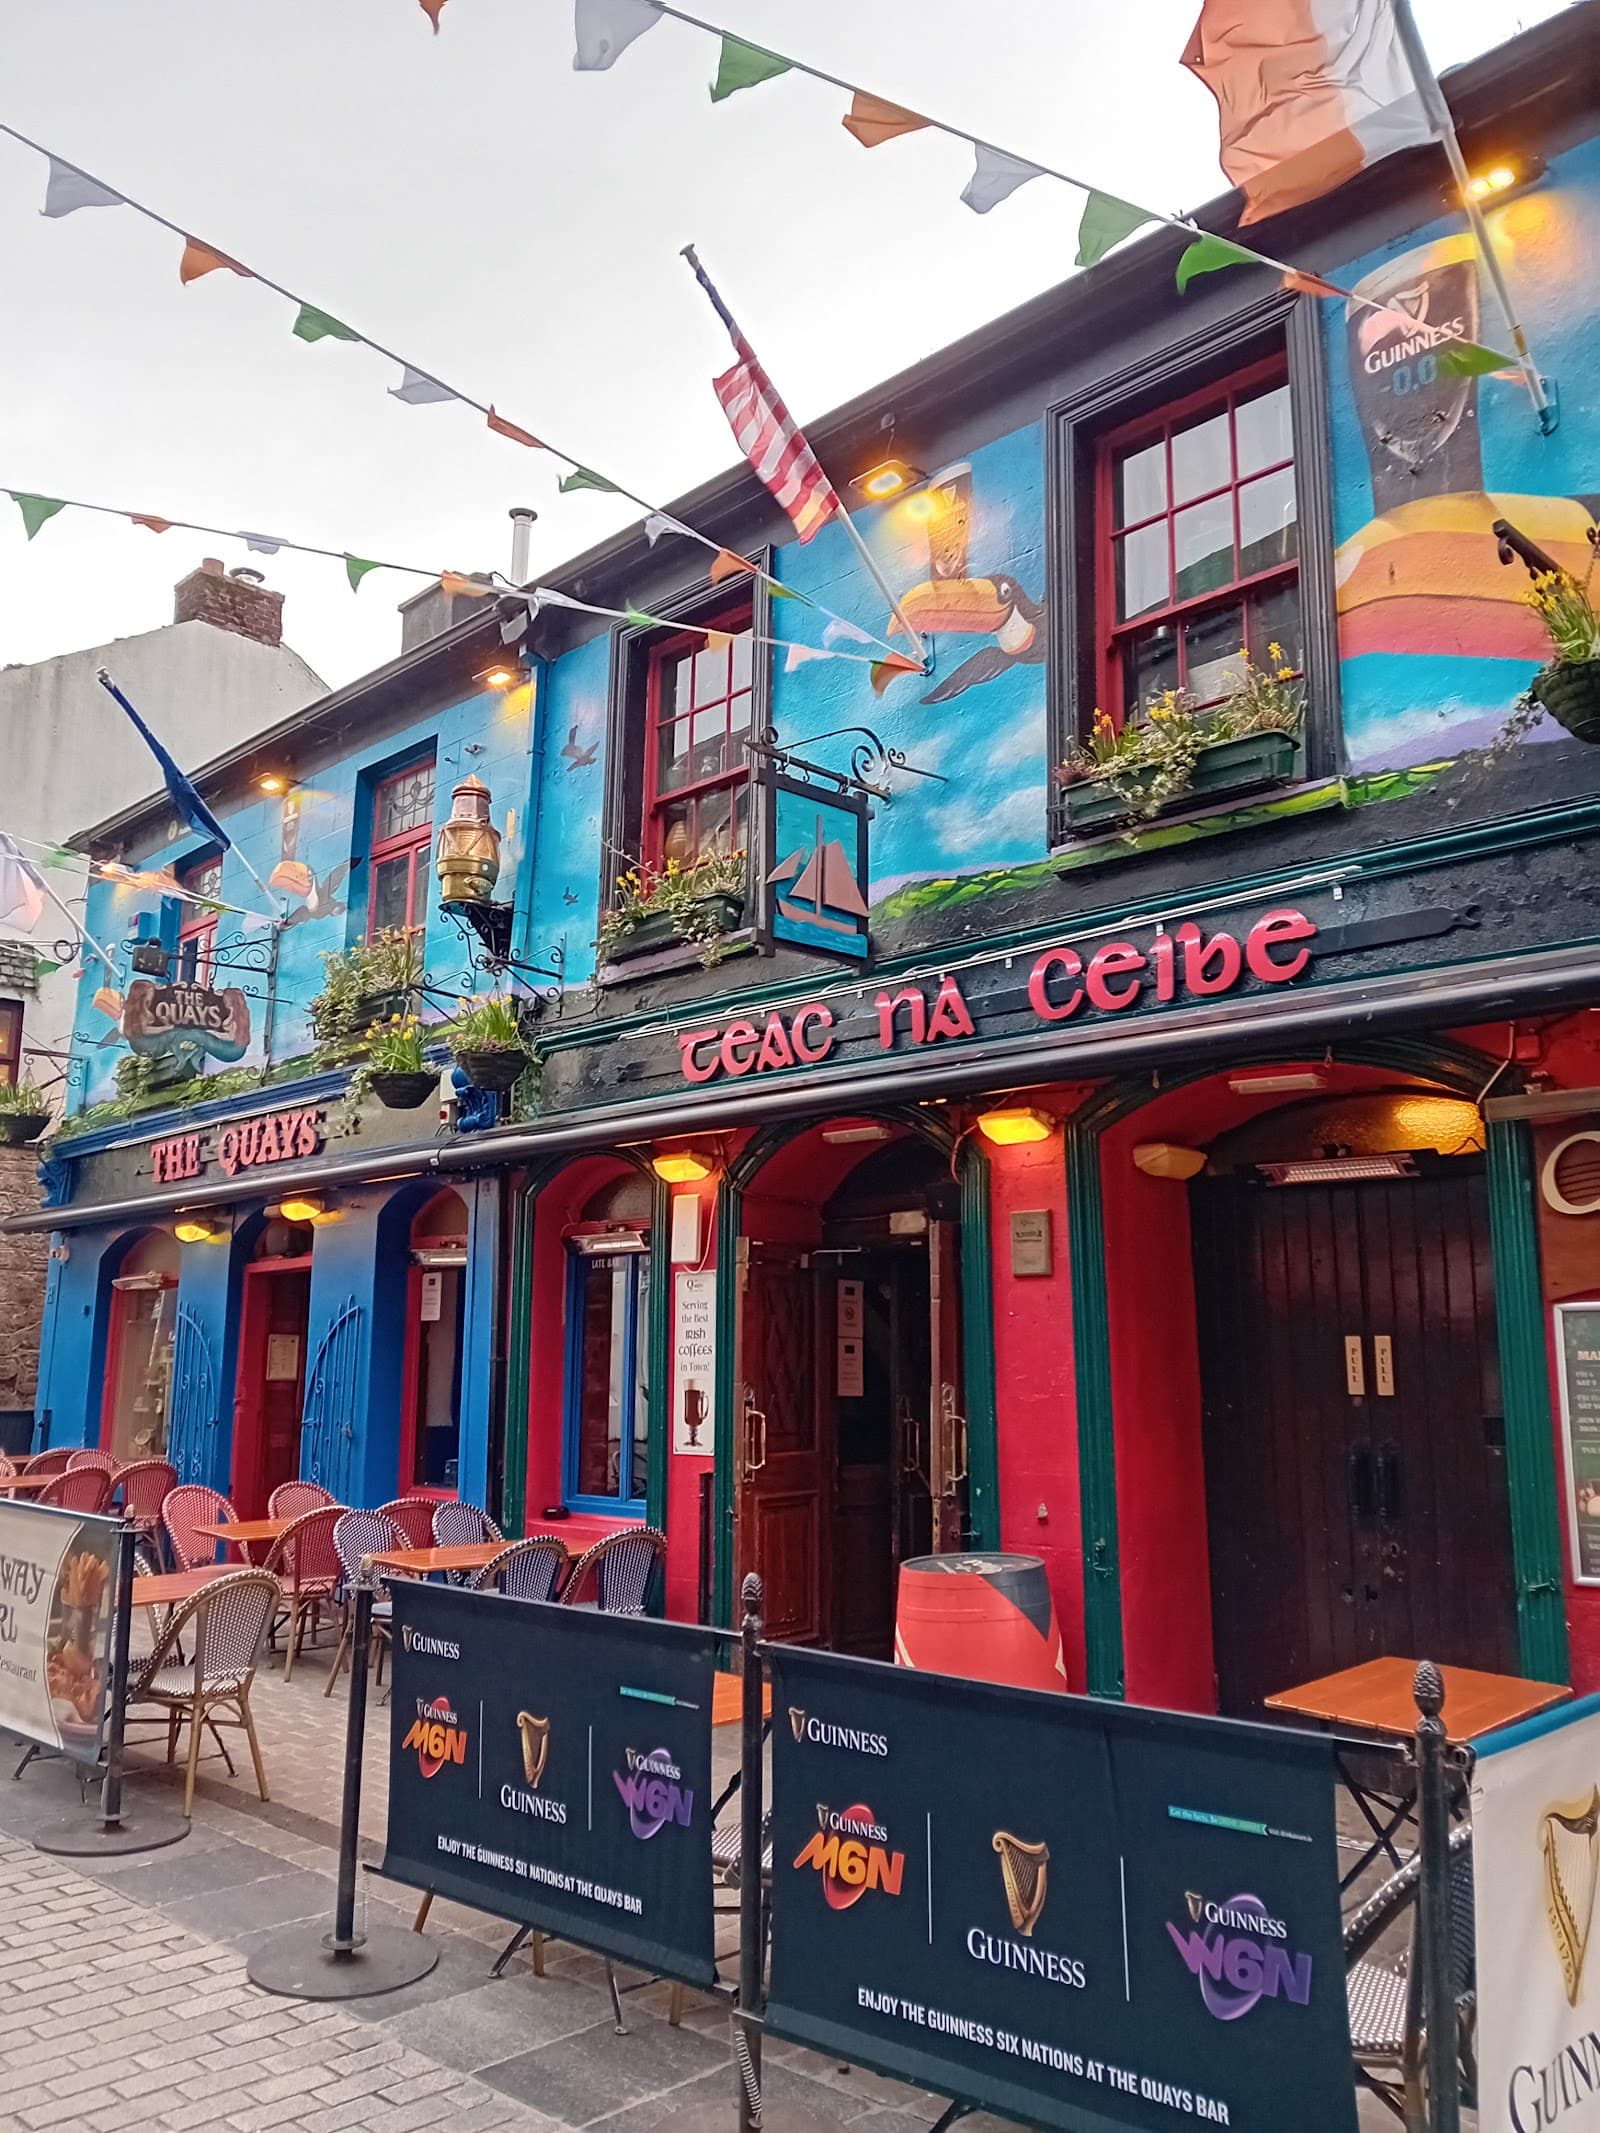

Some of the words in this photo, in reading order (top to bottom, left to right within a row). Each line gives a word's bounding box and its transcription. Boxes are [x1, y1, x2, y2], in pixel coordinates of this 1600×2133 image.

[1364, 317, 1464, 374] GUINNESS
[1393, 353, 1438, 395] 0.0
[155, 1002, 221, 1027] QUAYS
[174, 990, 203, 1006] THE
[151, 1134, 199, 1183] THE
[218, 1109, 317, 1176] QUAYS
[682, 1301, 708, 1310] Serving
[682, 1313, 691, 1323] the
[694, 1313, 708, 1323] Best
[680, 1363, 687, 1372] in
[412, 1632, 460, 1660] GUINNESS
[0, 1655, 37, 1682] estaurant
[423, 1705, 458, 1725] GUINNESS
[402, 1719, 467, 1765] M6N
[807, 1718, 888, 1756] GUINNESS
[635, 1754, 681, 1780] GUINNESS
[500, 1784, 567, 1824] GUINNESS
[613, 1769, 694, 1827] W6N
[829, 1812, 888, 1841] GUINNESS
[437, 1835, 462, 1855] ENJOY
[461, 1842, 477, 1860] THE
[477, 1847, 515, 1873] GUINNESS
[515, 1859, 528, 1878] SIX
[529, 1865, 564, 1889] NATIONS
[564, 1876, 576, 1893] AT
[576, 1879, 593, 1899] THE
[594, 1886, 623, 1908] QUAYS
[624, 1895, 642, 1915] BAR
[793, 1832, 905, 1895] M6N
[1205, 1902, 1287, 1939] GUINNESS
[967, 1928, 1086, 1989] GUINNESS
[1165, 1921, 1313, 2006] W6N
[857, 1987, 899, 2016] ENJOY
[900, 2000, 926, 2025] THE
[927, 2009, 994, 2047] GUINNESS
[997, 2031, 1019, 2055] SIX
[1022, 2038, 1083, 2076] NATIONS
[1086, 2060, 1105, 2083] AT
[1107, 2066, 1138, 2095] THE
[1141, 2077, 1193, 2113] QUAYS
[1196, 2094, 1231, 2126] BAR
